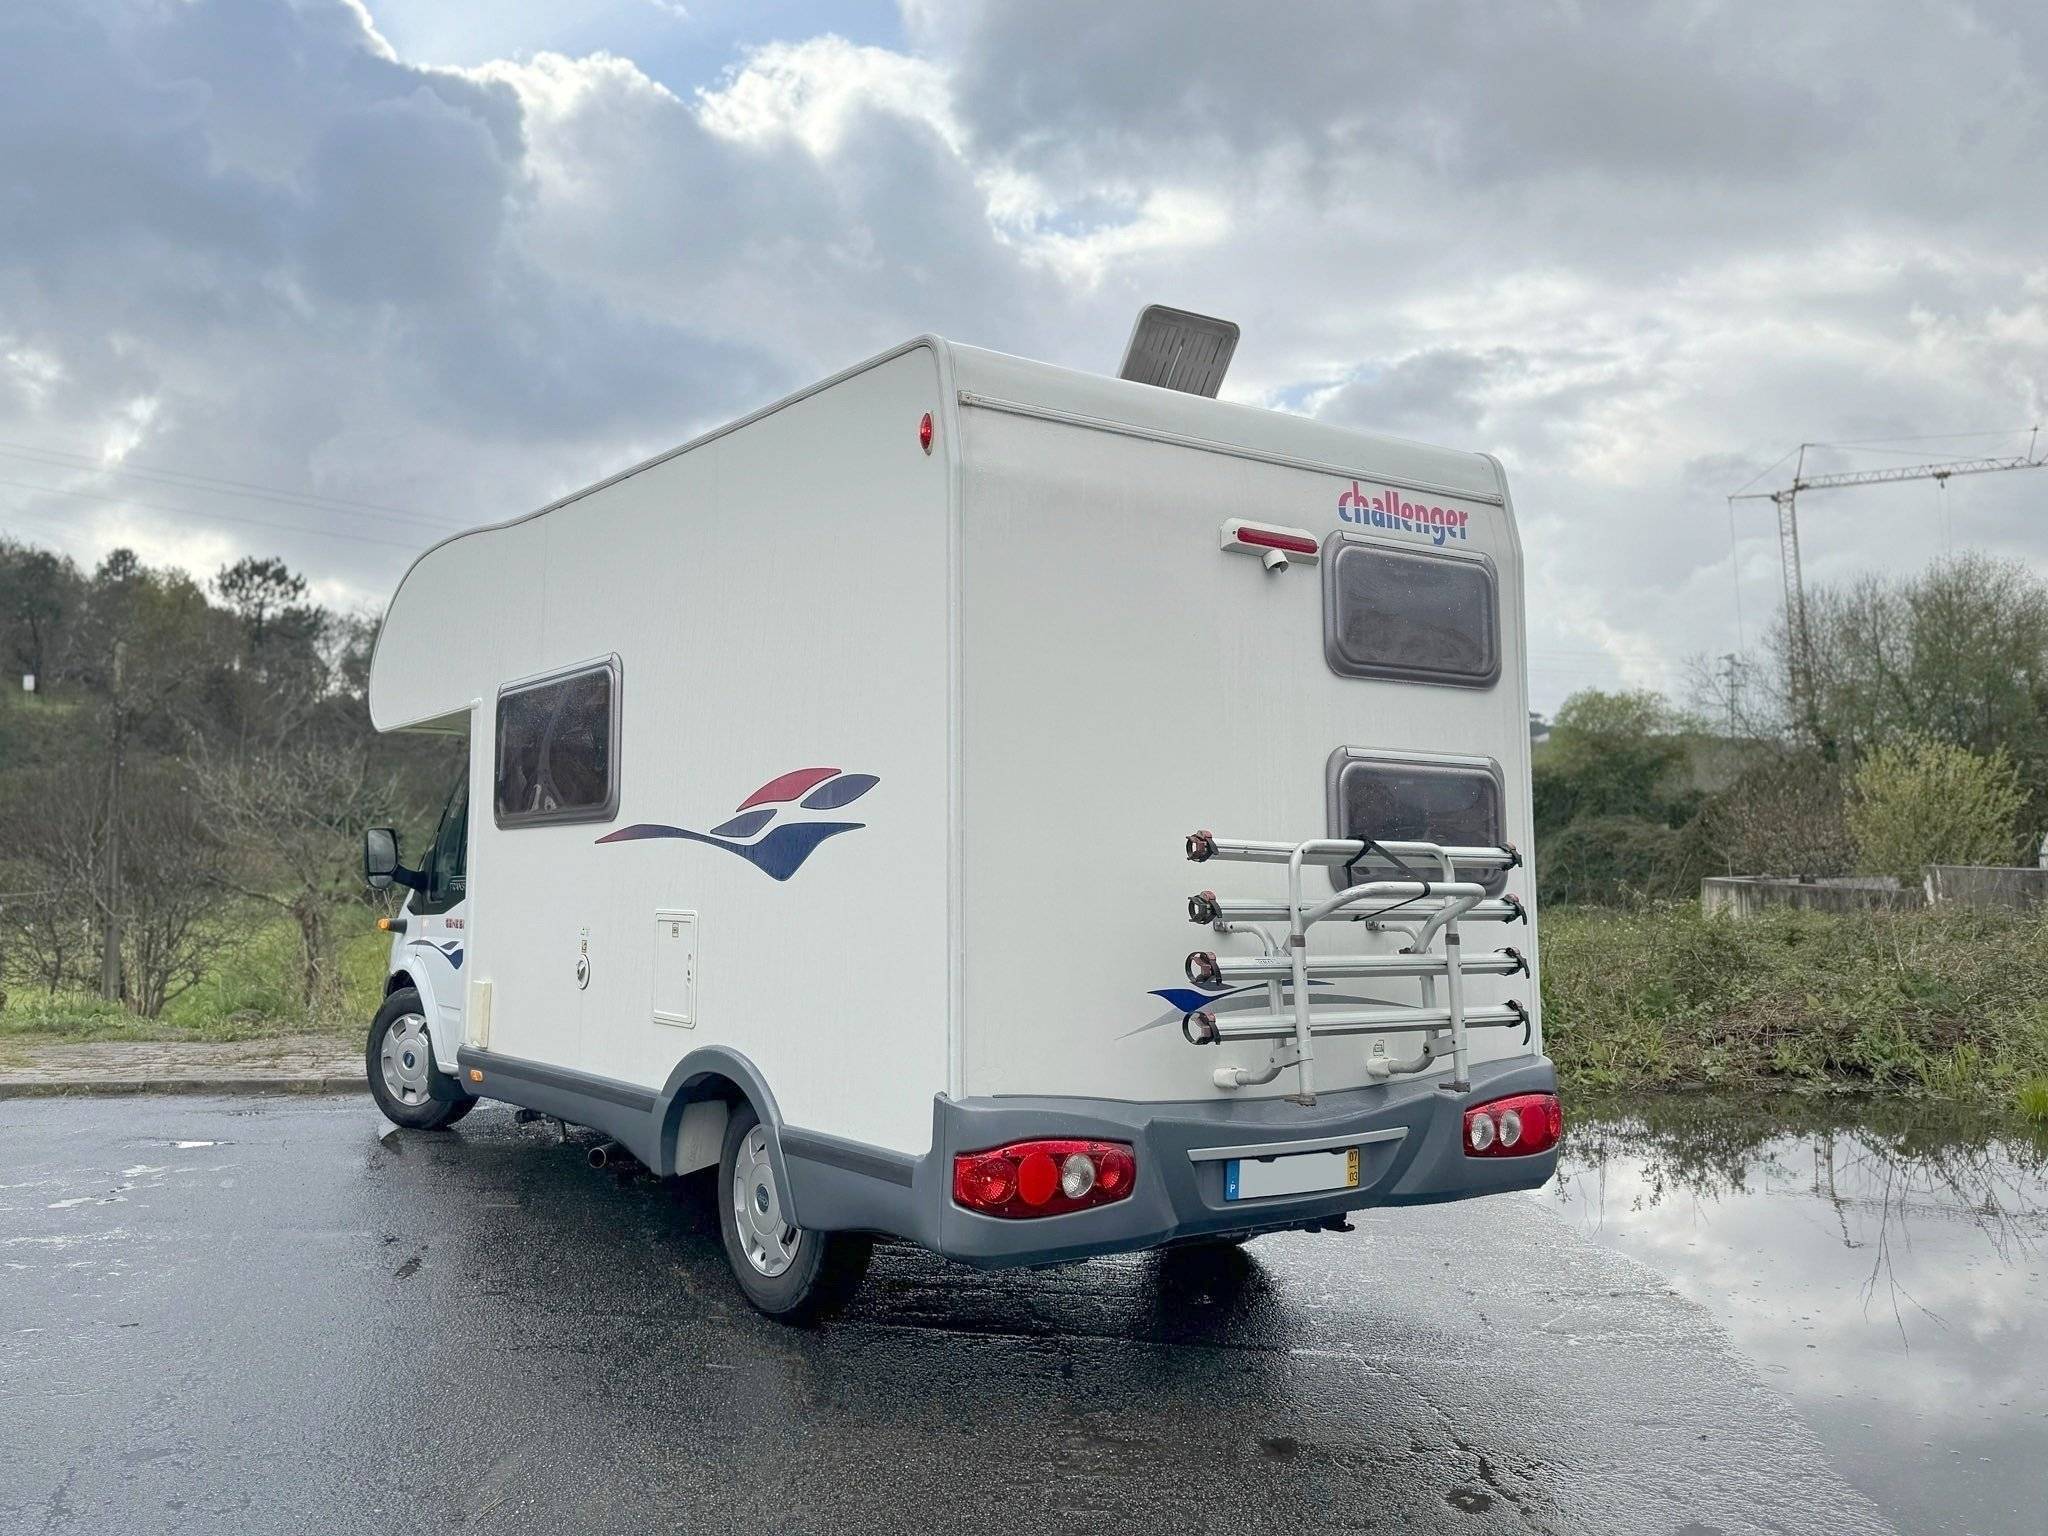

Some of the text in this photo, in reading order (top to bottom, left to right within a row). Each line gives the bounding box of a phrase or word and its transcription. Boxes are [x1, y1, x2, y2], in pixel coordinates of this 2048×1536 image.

[1339, 481, 1468, 545] challenger
[1349, 1151, 1357, 1161] 07
[1349, 1172, 1357, 1181] 03
[1230, 1184, 1236, 1193] P
